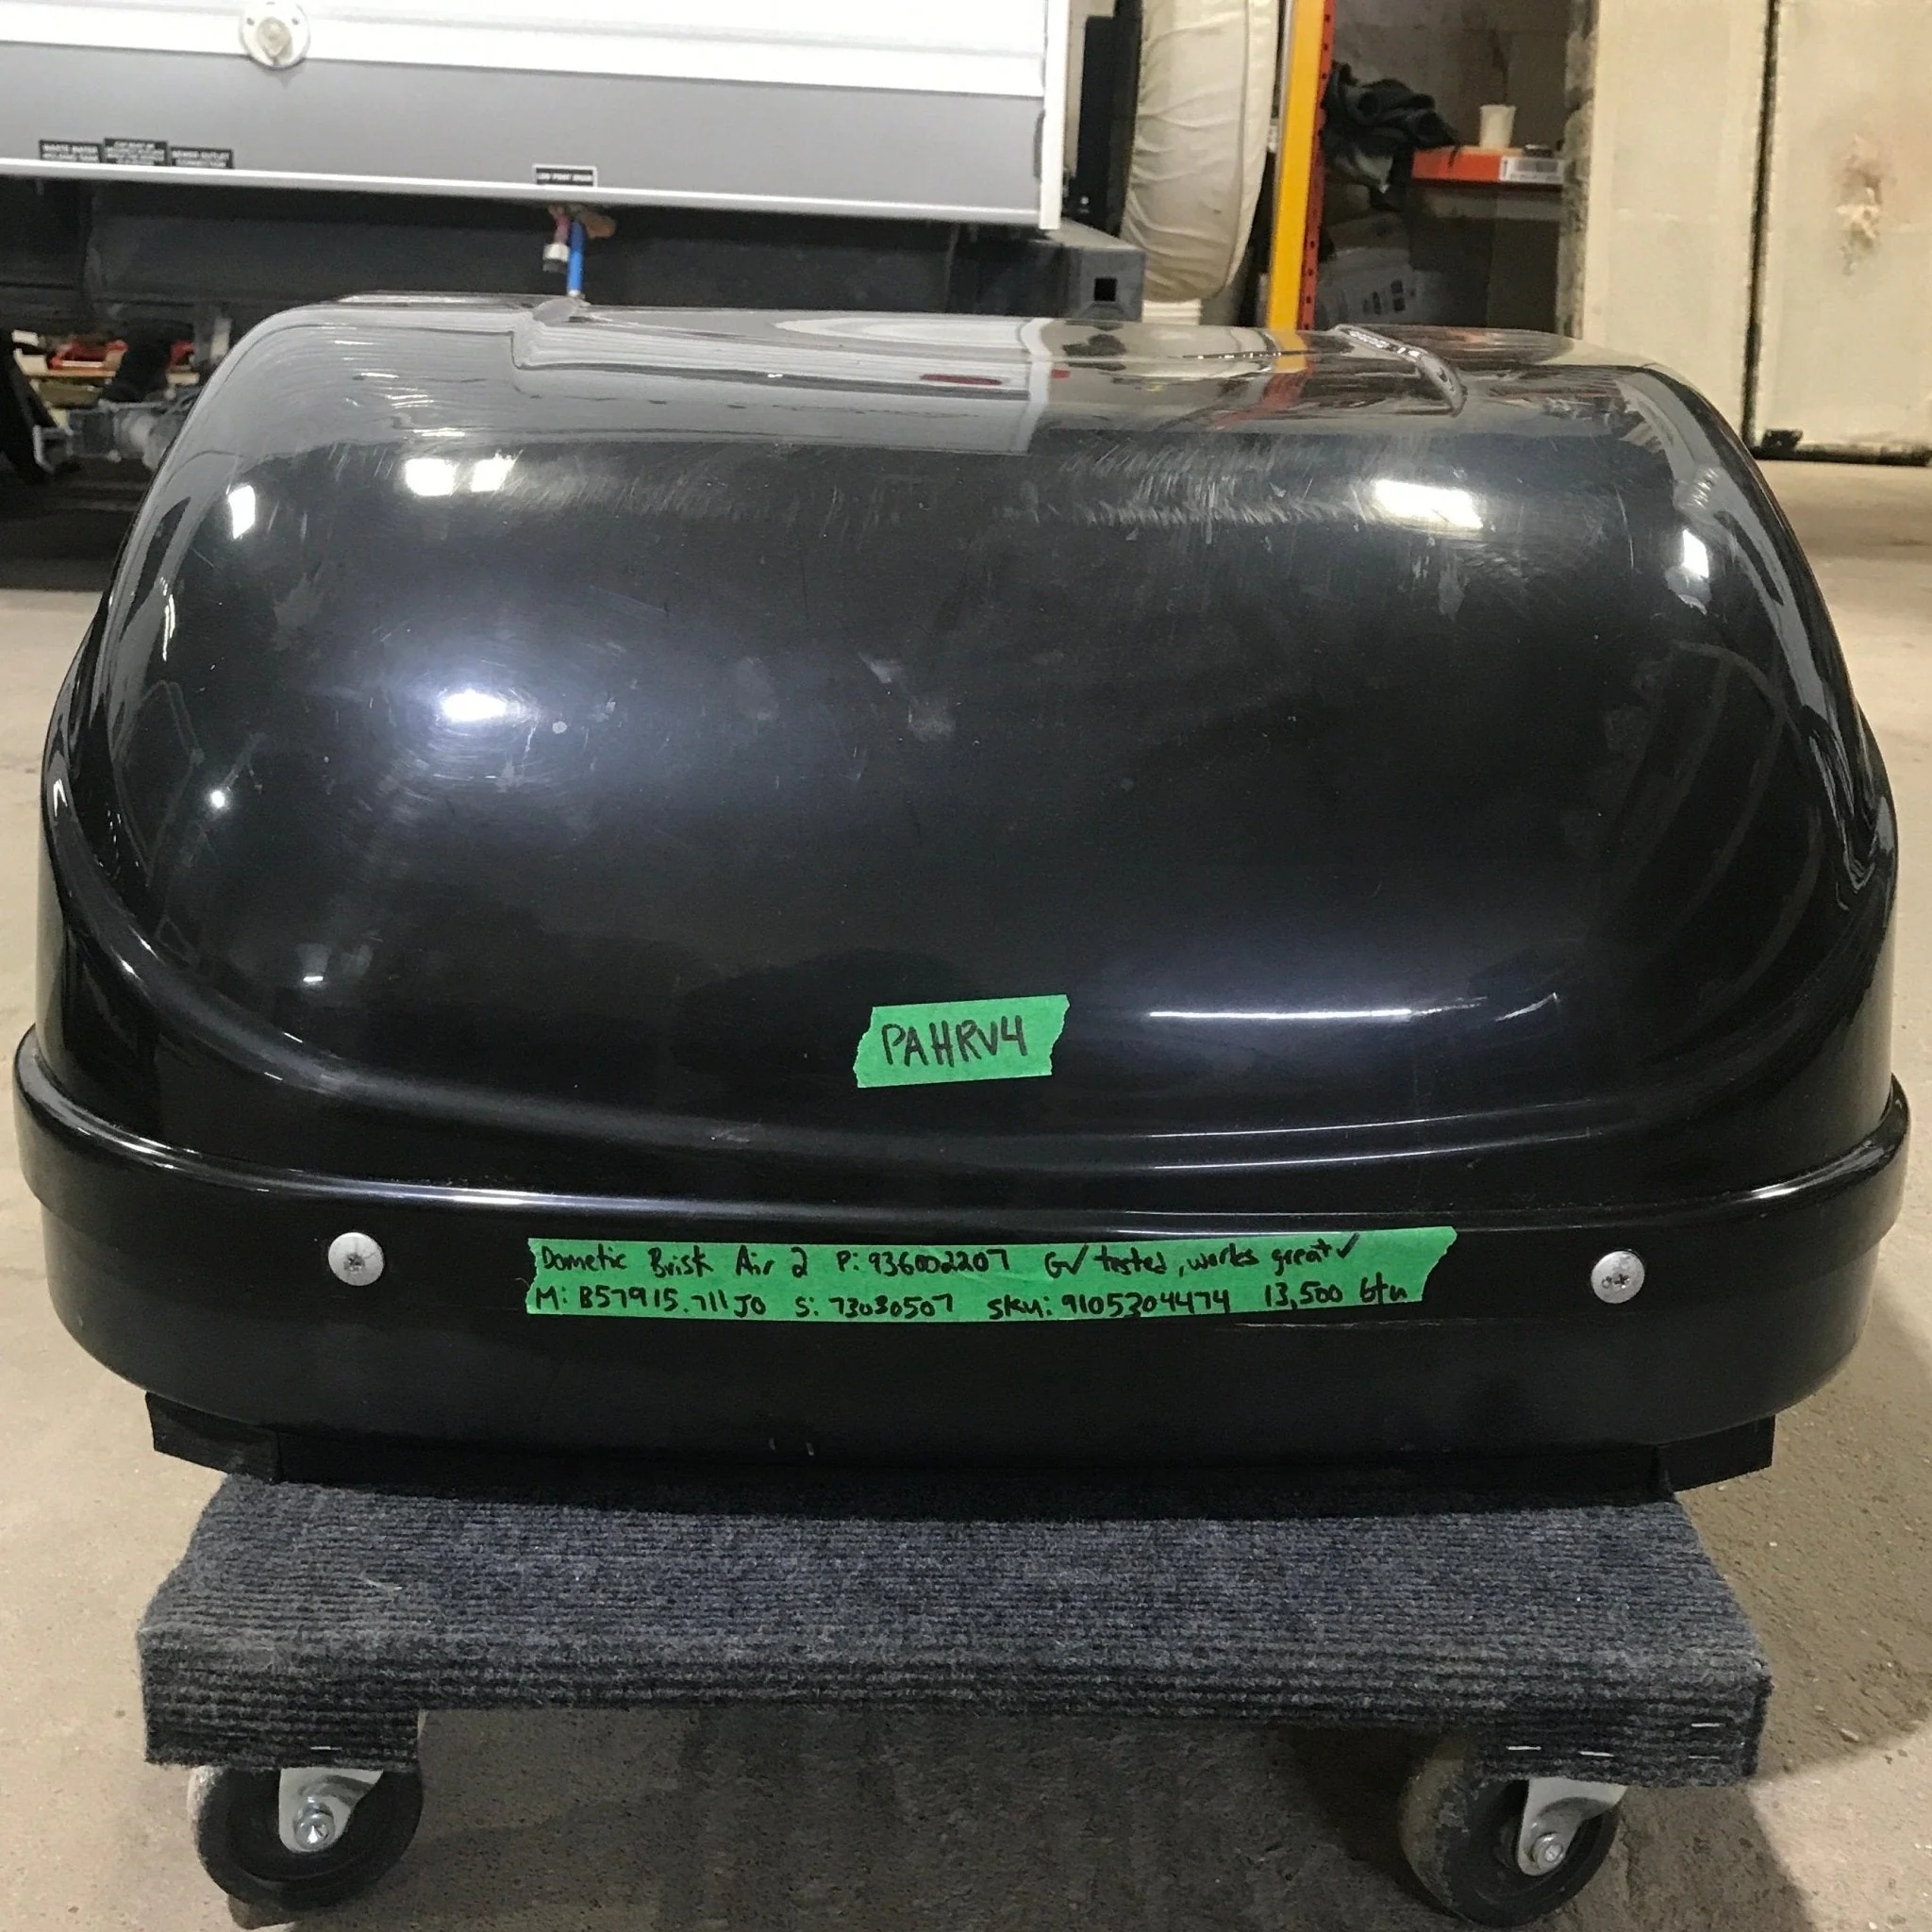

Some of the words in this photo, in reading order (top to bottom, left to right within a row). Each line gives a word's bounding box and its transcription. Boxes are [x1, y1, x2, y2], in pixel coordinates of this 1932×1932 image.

[881, 1014, 1028, 1068] PAHRV4
[541, 1243, 627, 1271] Dometic
[648, 1244, 713, 1278] Brisk
[736, 1244, 775, 1275] Air
[791, 1246, 808, 1278] 2
[836, 1250, 859, 1272] P:
[535, 1285, 568, 1310] M:
[794, 1296, 819, 1317] S:
[828, 1292, 953, 1320] 73030507
[1264, 1280, 1343, 1310] 13,500
